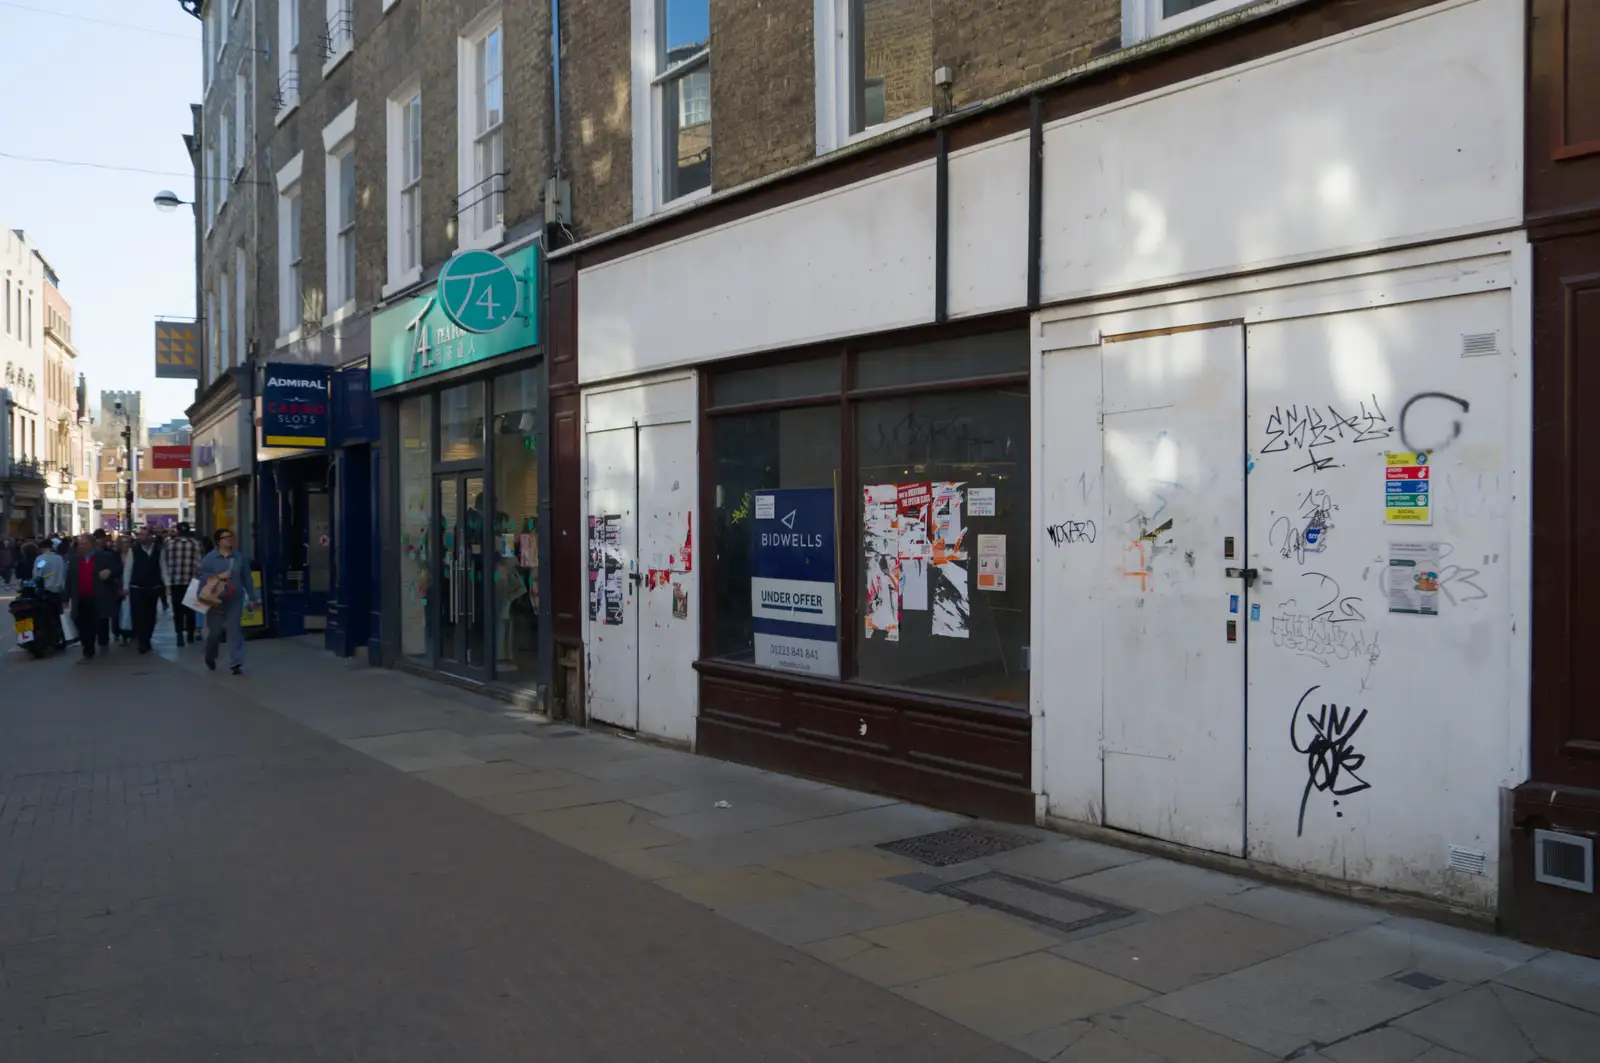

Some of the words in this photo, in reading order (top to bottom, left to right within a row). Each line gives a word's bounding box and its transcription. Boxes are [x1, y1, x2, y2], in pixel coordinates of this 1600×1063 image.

[267, 377, 326, 390] ADMIRAL
[268, 402, 325, 415] CASINO
[278, 415, 316, 424] SLOTS
[761, 532, 823, 548] BIDWELLS
[761, 590, 791, 605] UNDER
[792, 593, 823, 608] OFFER
[791, 647, 804, 659] 841
[805, 649, 819, 660] 841
